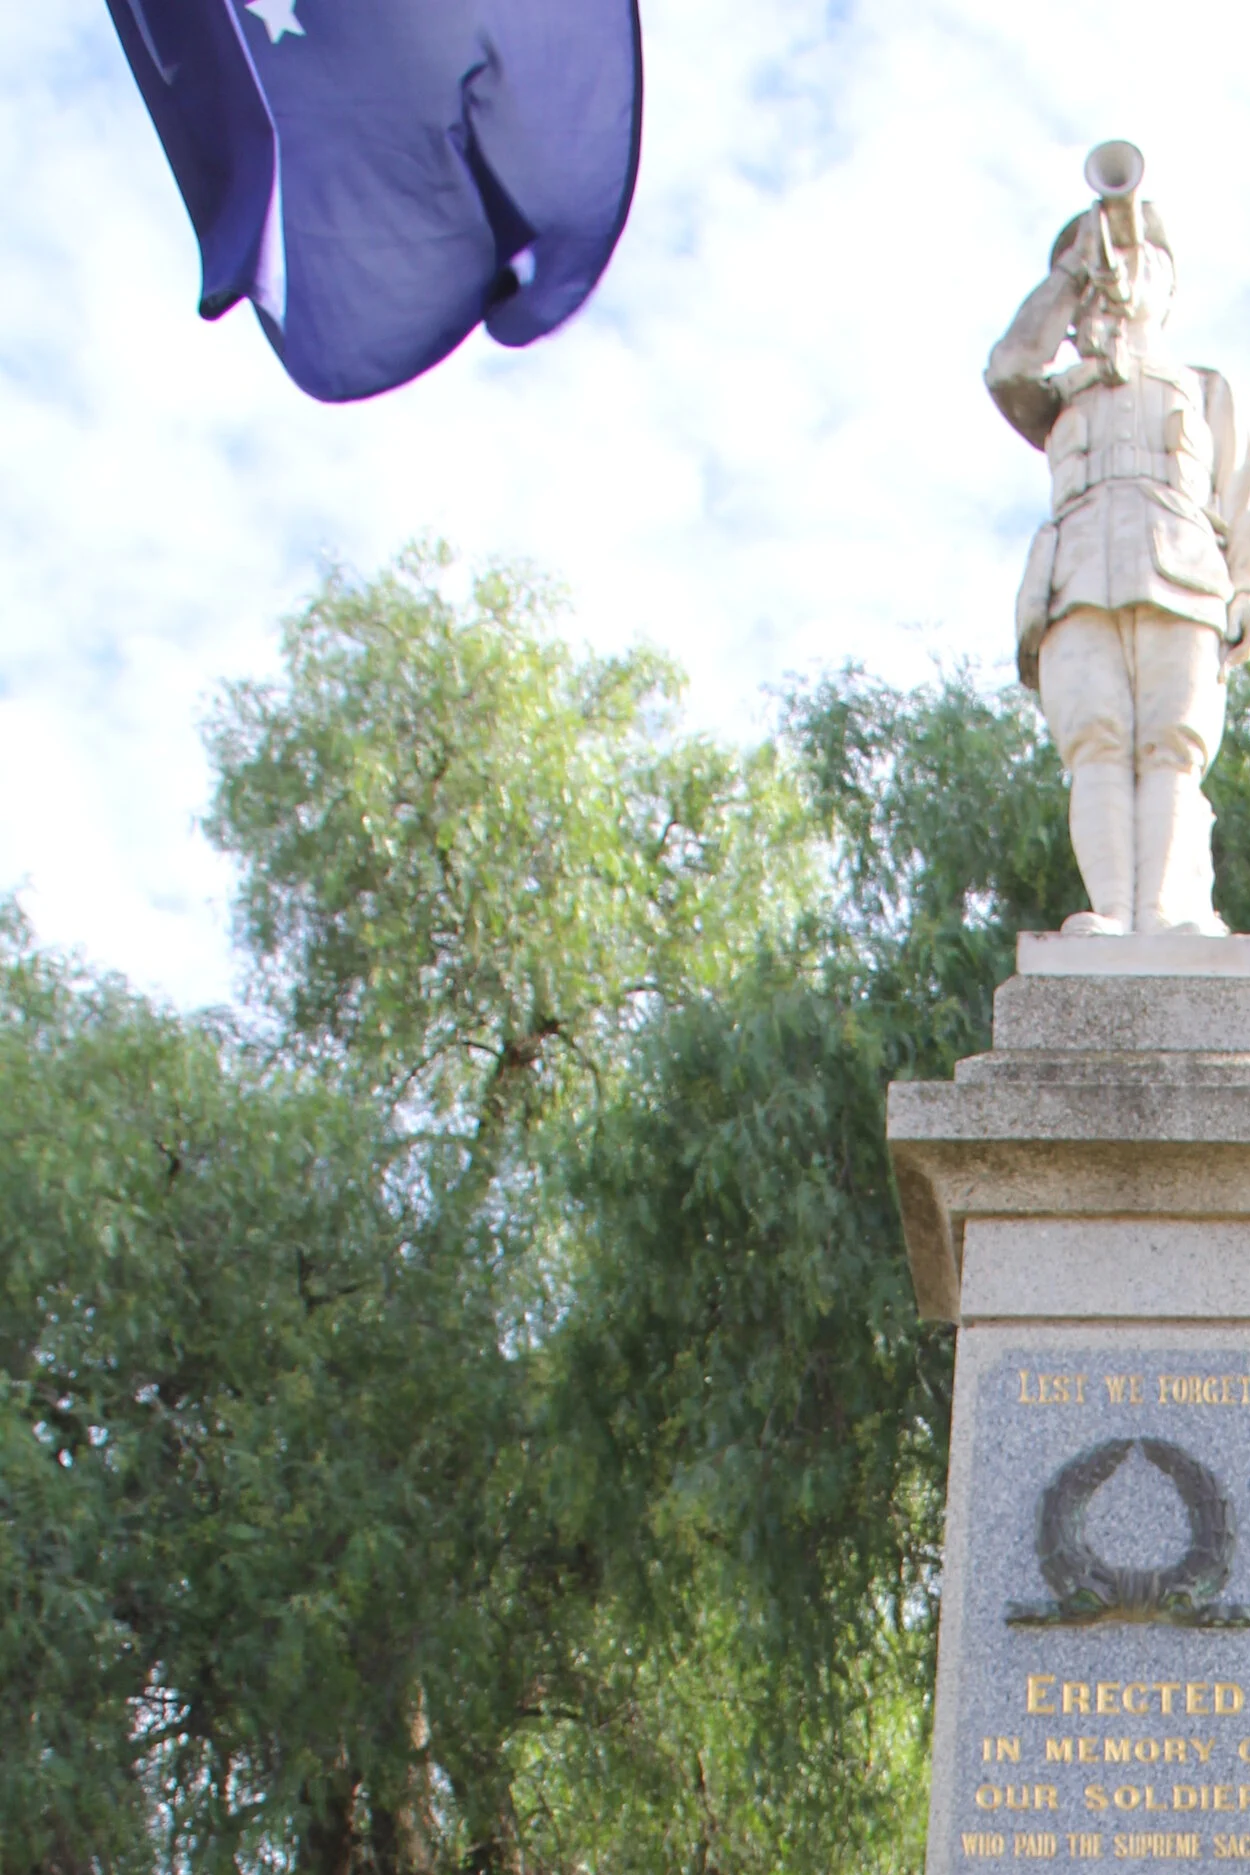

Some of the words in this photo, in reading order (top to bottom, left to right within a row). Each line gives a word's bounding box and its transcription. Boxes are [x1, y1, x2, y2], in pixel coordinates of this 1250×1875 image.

[1018, 1370, 1088, 1405] LEST
[1105, 1375, 1144, 1405] WE
[1026, 1674, 1245, 1715] ERECTED
[982, 1737, 1020, 1763] IN
[1045, 1738, 1216, 1763] MEMORY
[975, 1784, 1059, 1811] OUR
[962, 1834, 1004, 1858] WHO
[1013, 1833, 1056, 1858] PAID
[1067, 1833, 1101, 1858] THE
[1114, 1834, 1202, 1859] SUPREME
